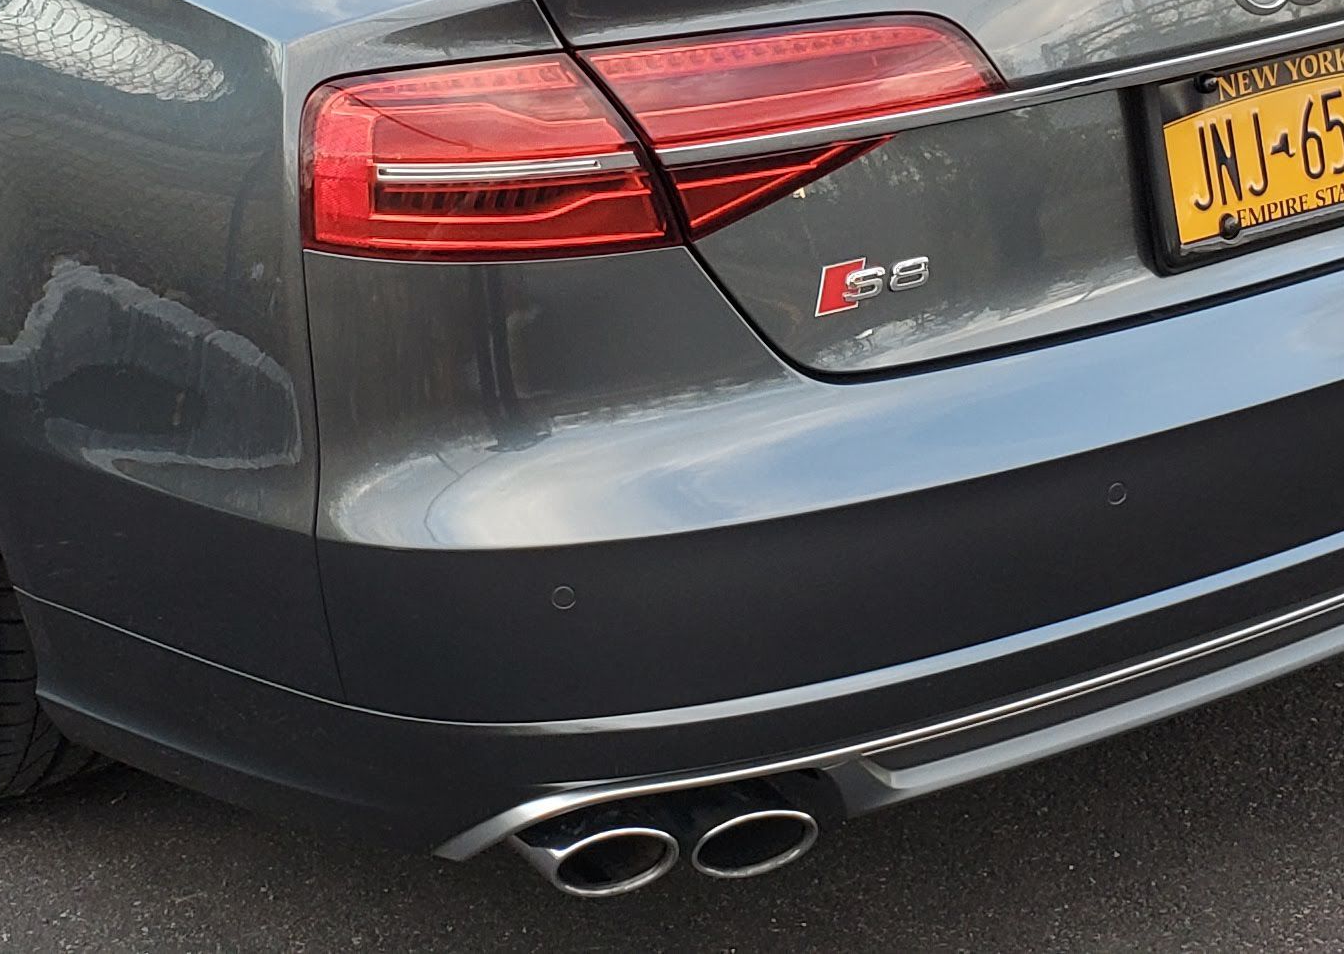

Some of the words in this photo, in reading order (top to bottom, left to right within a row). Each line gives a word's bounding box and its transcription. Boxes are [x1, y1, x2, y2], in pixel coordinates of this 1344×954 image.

[1216, 64, 1278, 101] NEW
[1236, 193, 1308, 227] EMPIRE
[842, 256, 930, 303] S8
